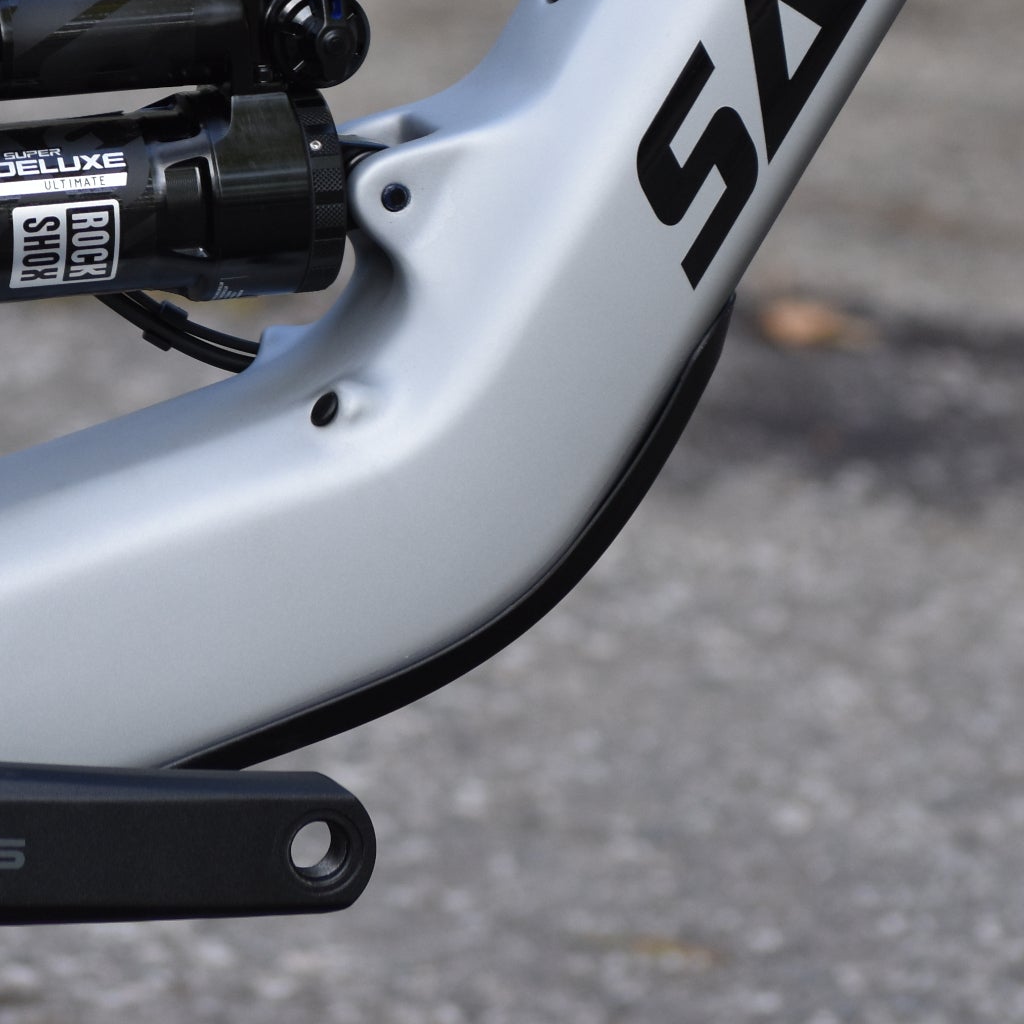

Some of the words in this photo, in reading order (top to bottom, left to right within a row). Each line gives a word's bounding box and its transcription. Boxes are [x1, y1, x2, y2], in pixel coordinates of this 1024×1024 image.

[3, 148, 61, 160] SUPER
[44, 176, 106, 190] ULTIMATE
[20, 215, 61, 282] SHOX
[68, 210, 110, 278] ROCK
